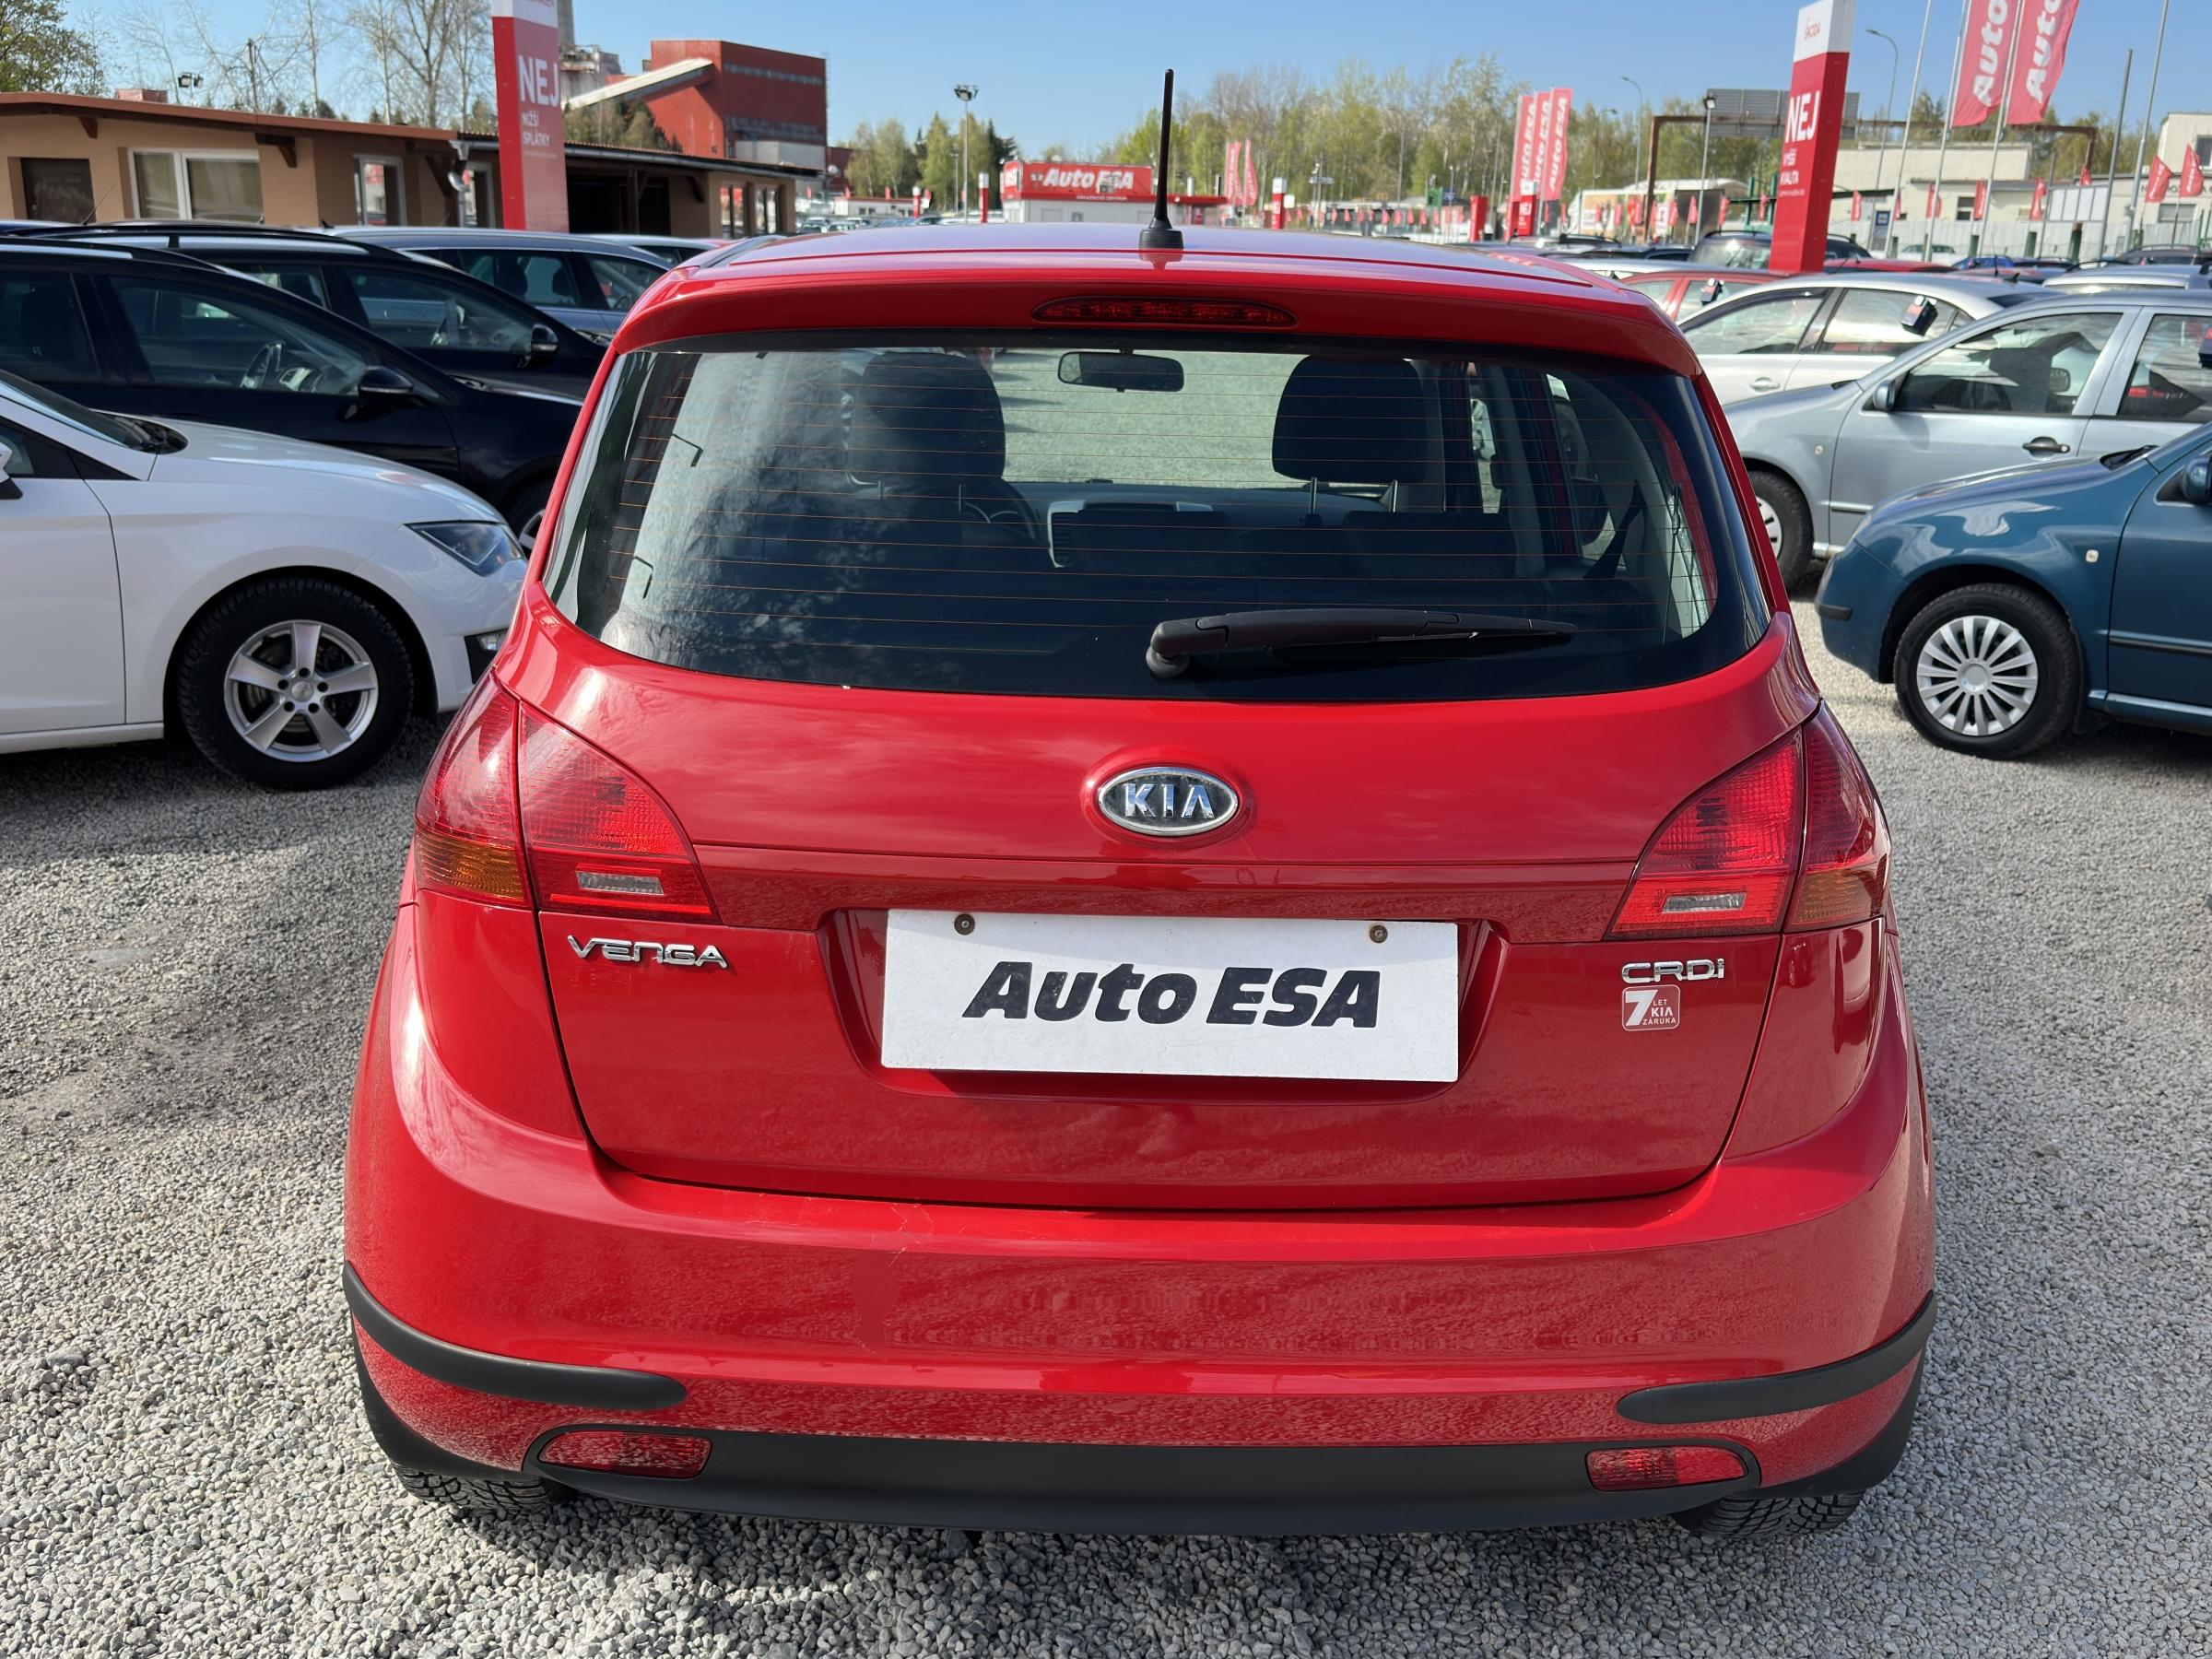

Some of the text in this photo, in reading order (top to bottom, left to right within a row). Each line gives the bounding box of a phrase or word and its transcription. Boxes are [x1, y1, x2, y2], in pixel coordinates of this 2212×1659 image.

[518, 54, 559, 107] NEJ
[1784, 90, 1820, 144] NEJ
[1042, 168, 1096, 190] Auto
[1124, 782, 1215, 818] KIA
[567, 935, 728, 969] VENGA
[1621, 958, 1724, 984] CRDi
[961, 960, 1381, 1029] Auto ESA
[1625, 989, 1659, 1027] 7
[1653, 998, 1668, 1006] LET
[1642, 1016, 1677, 1026] ZÁRUKA
[1651, 1006, 1673, 1018] KIA
